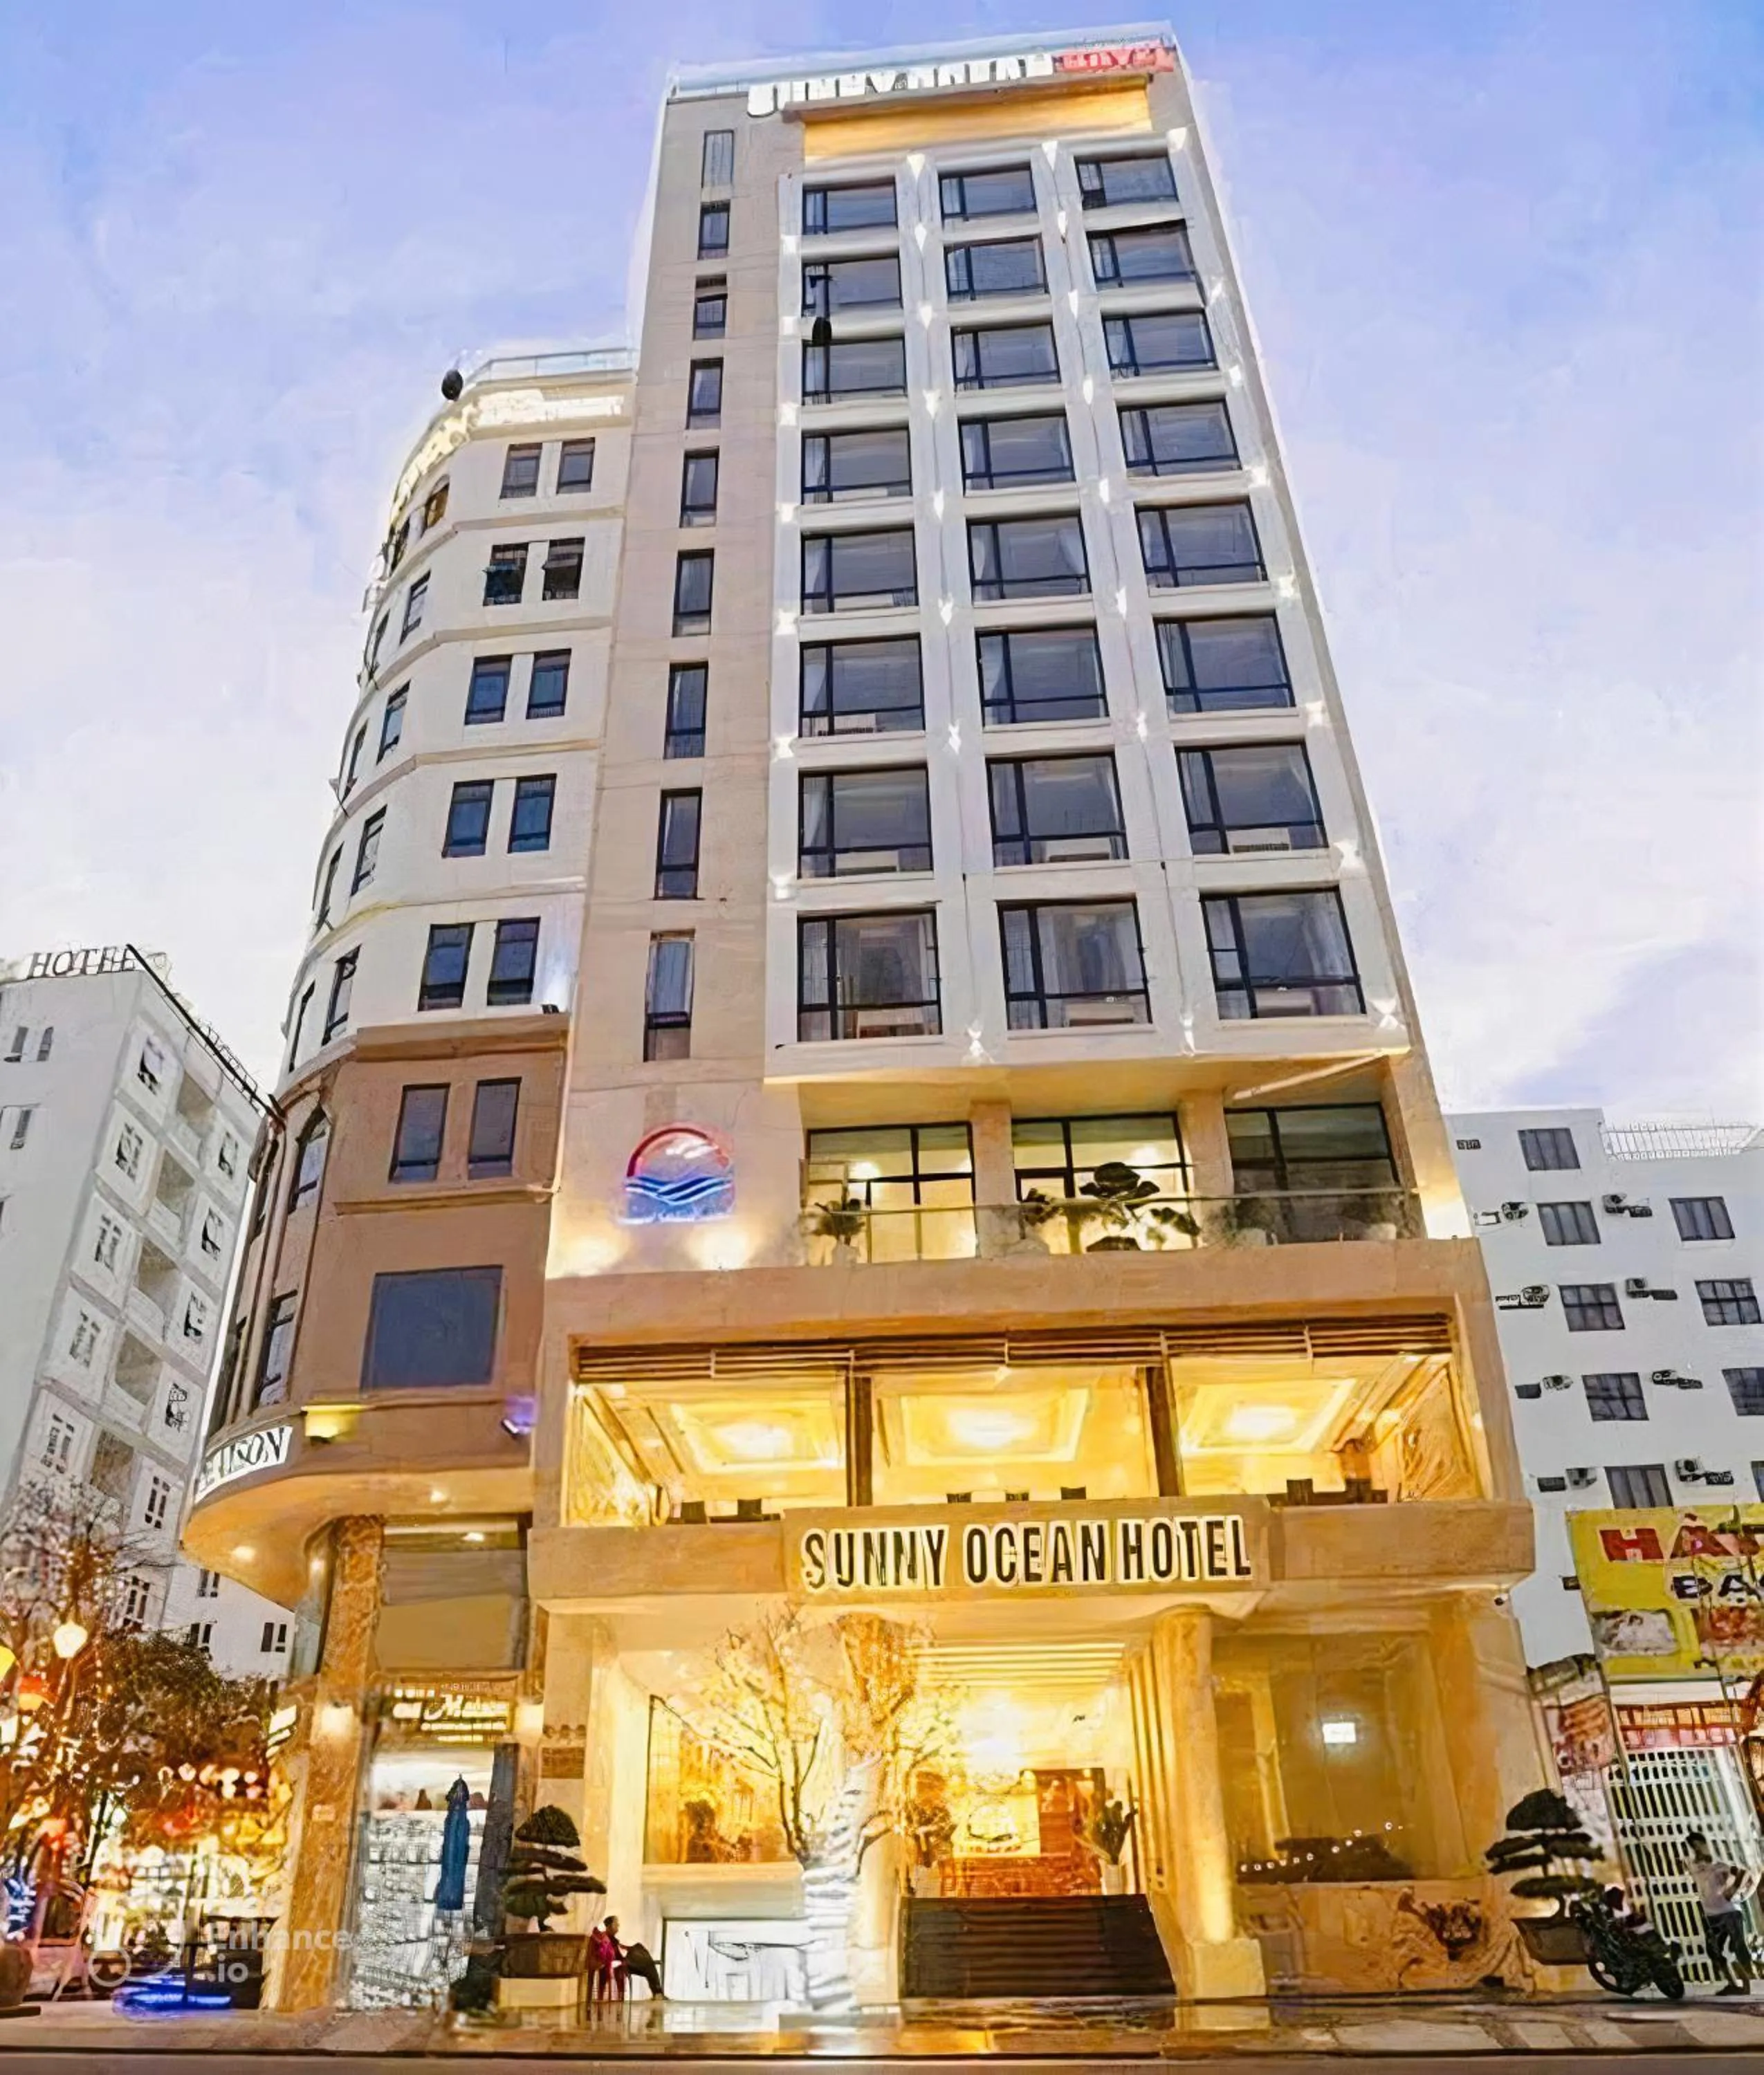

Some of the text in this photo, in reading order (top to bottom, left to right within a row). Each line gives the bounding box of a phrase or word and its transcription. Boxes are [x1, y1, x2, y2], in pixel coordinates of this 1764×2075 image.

[800, 1515, 1253, 1592] SUNNY OCEAN HOTEL
